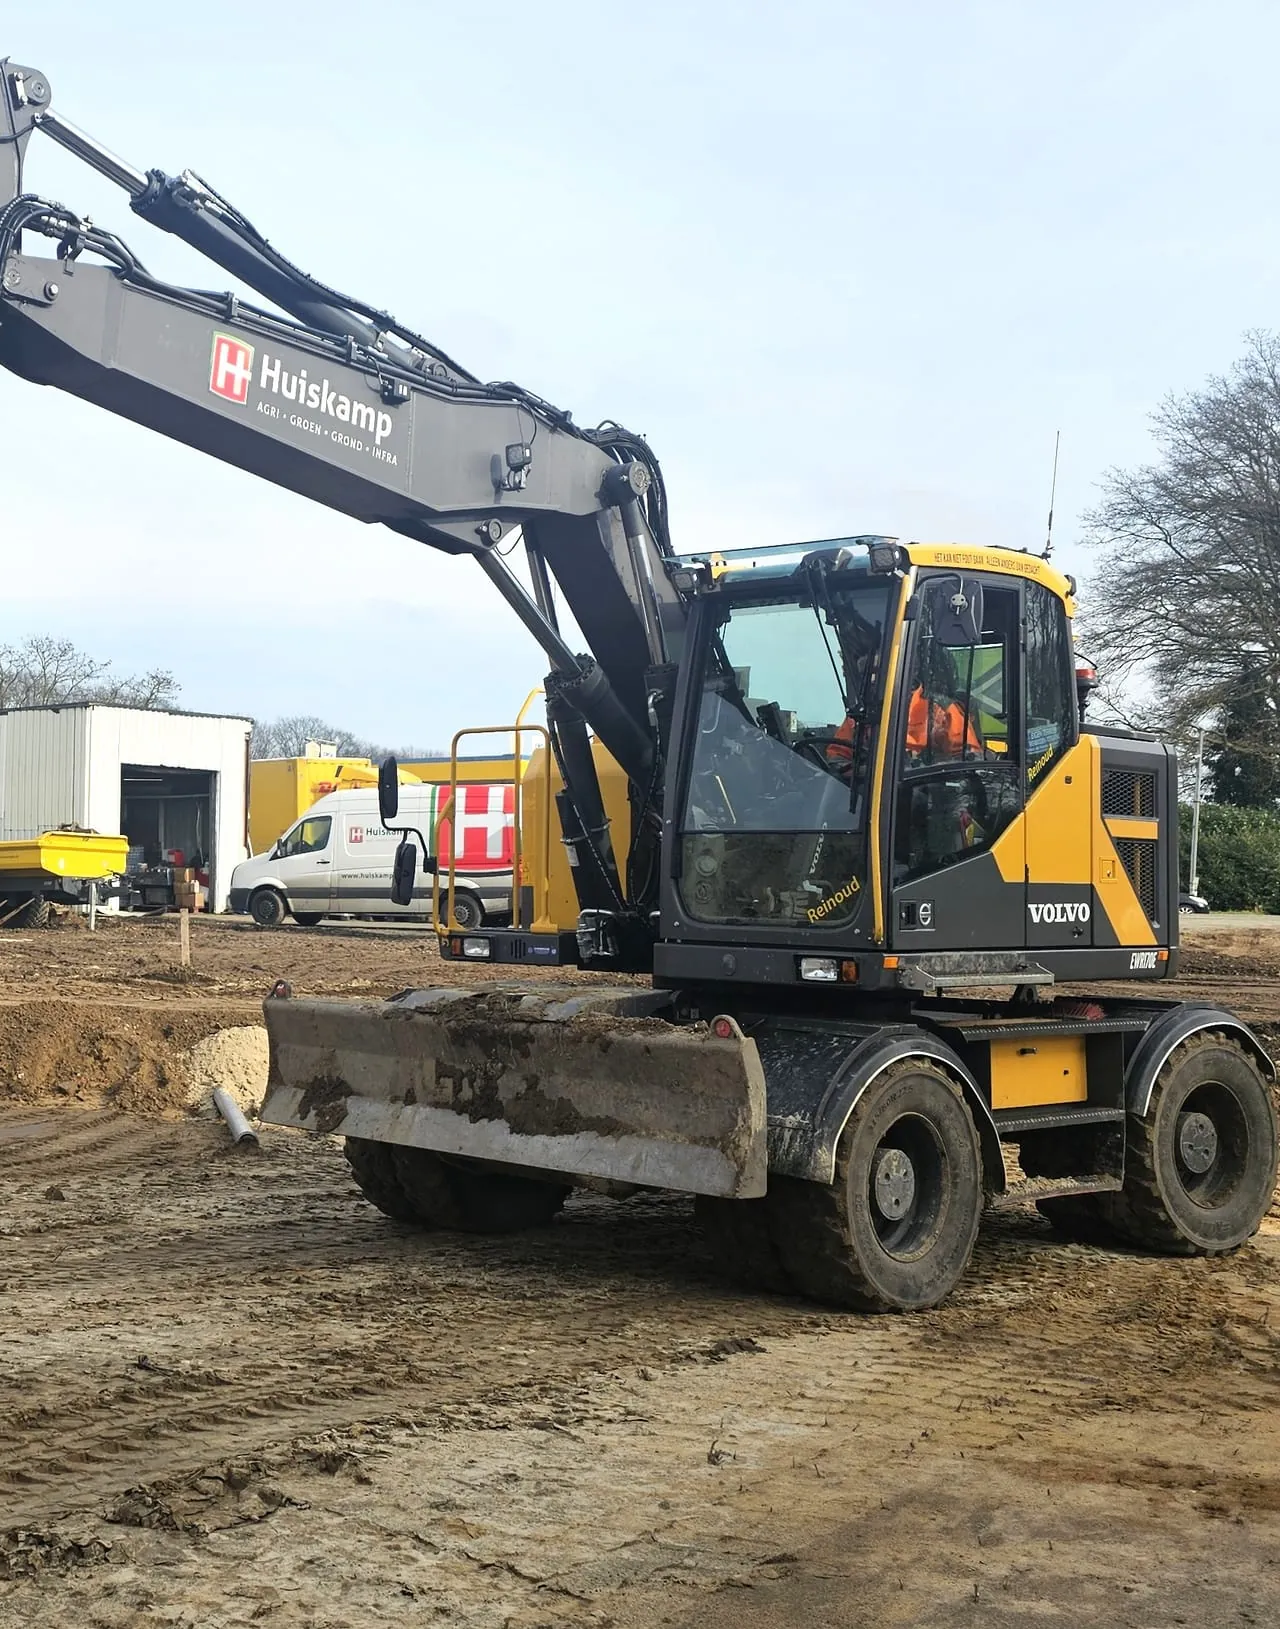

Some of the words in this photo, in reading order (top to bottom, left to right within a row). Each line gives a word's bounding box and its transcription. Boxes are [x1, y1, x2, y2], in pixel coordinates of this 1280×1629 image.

[259, 353, 393, 446] Huiskamp
[256, 401, 280, 419] AGRI
[289, 414, 322, 436] GROEN
[331, 430, 363, 452] GROND
[372, 446, 398, 466] INFRA
[1027, 743, 1054, 783] Reinoud
[807, 875, 860, 924] Reinoud
[1028, 903, 1091, 923] VOLVO
